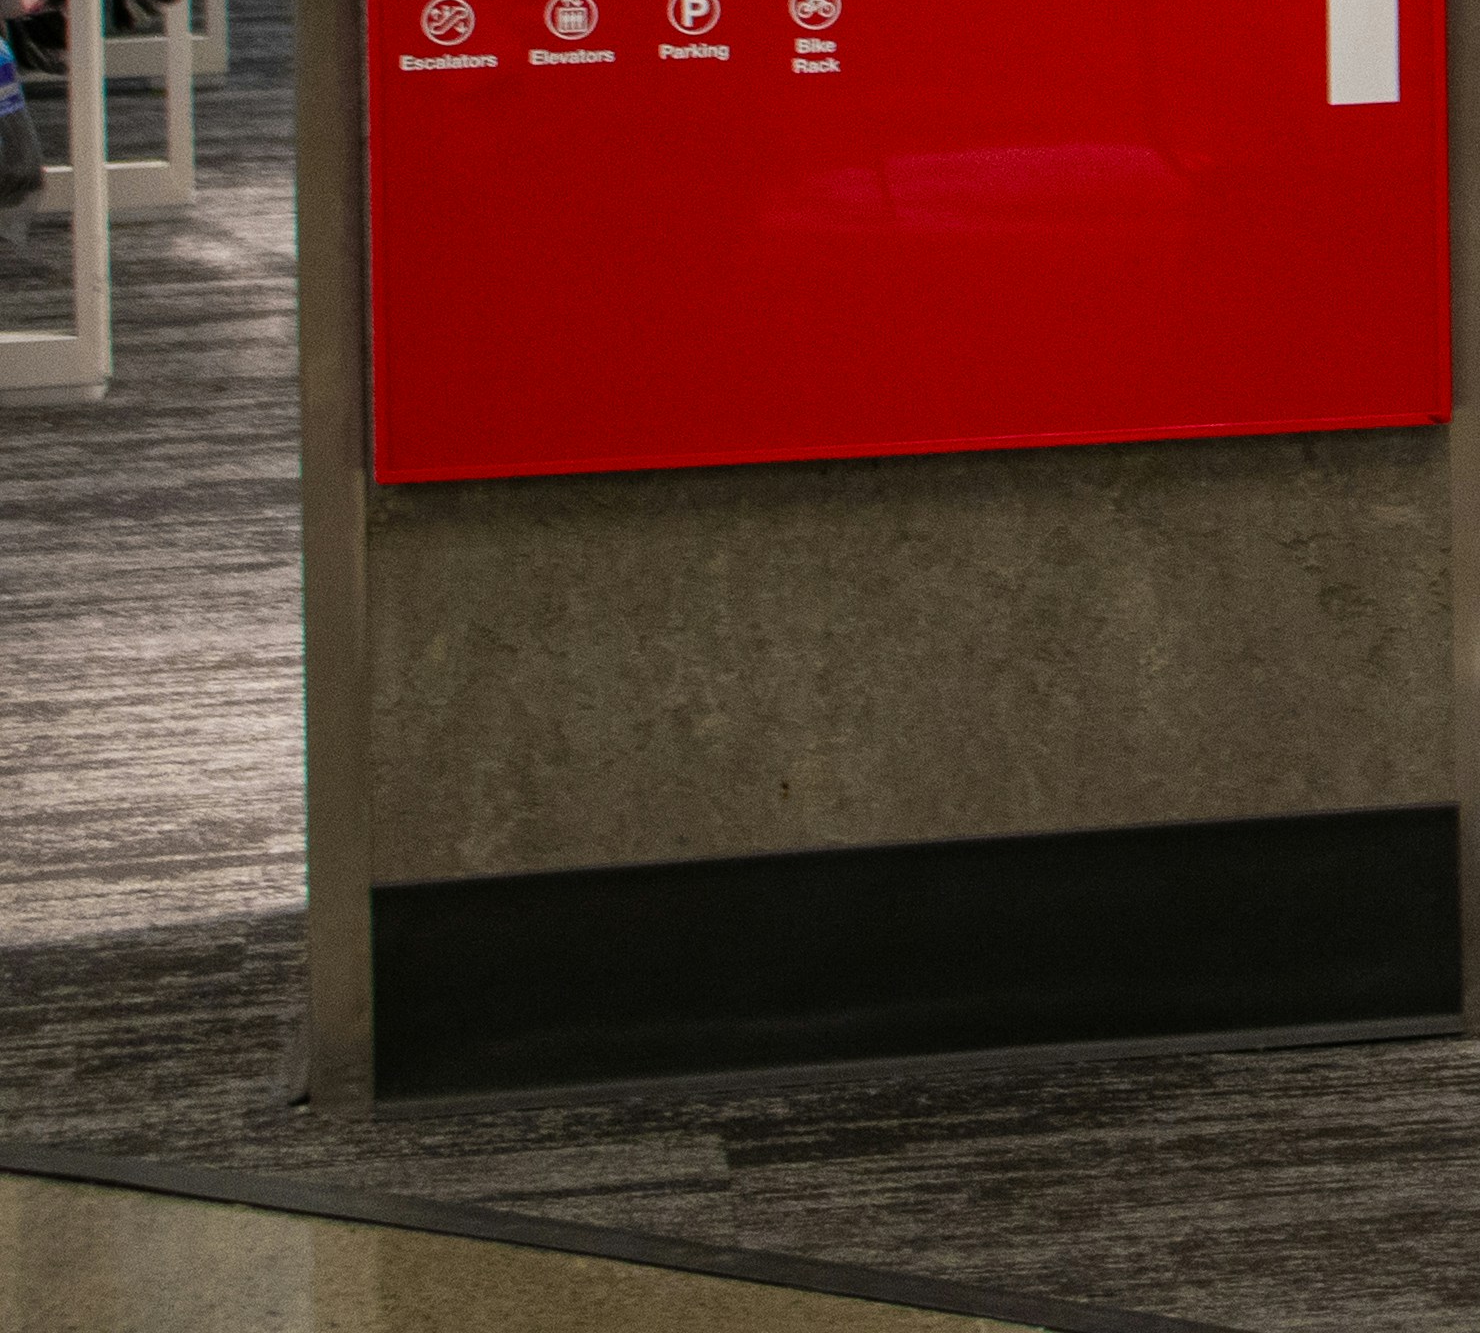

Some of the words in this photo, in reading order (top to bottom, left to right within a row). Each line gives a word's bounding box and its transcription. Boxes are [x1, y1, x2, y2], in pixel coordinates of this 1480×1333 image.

[658, 43, 730, 61] Parking
[794, 37, 837, 53] Bike
[399, 53, 498, 71] Escalators
[528, 48, 616, 65] Elevators
[791, 57, 841, 74] Rack
